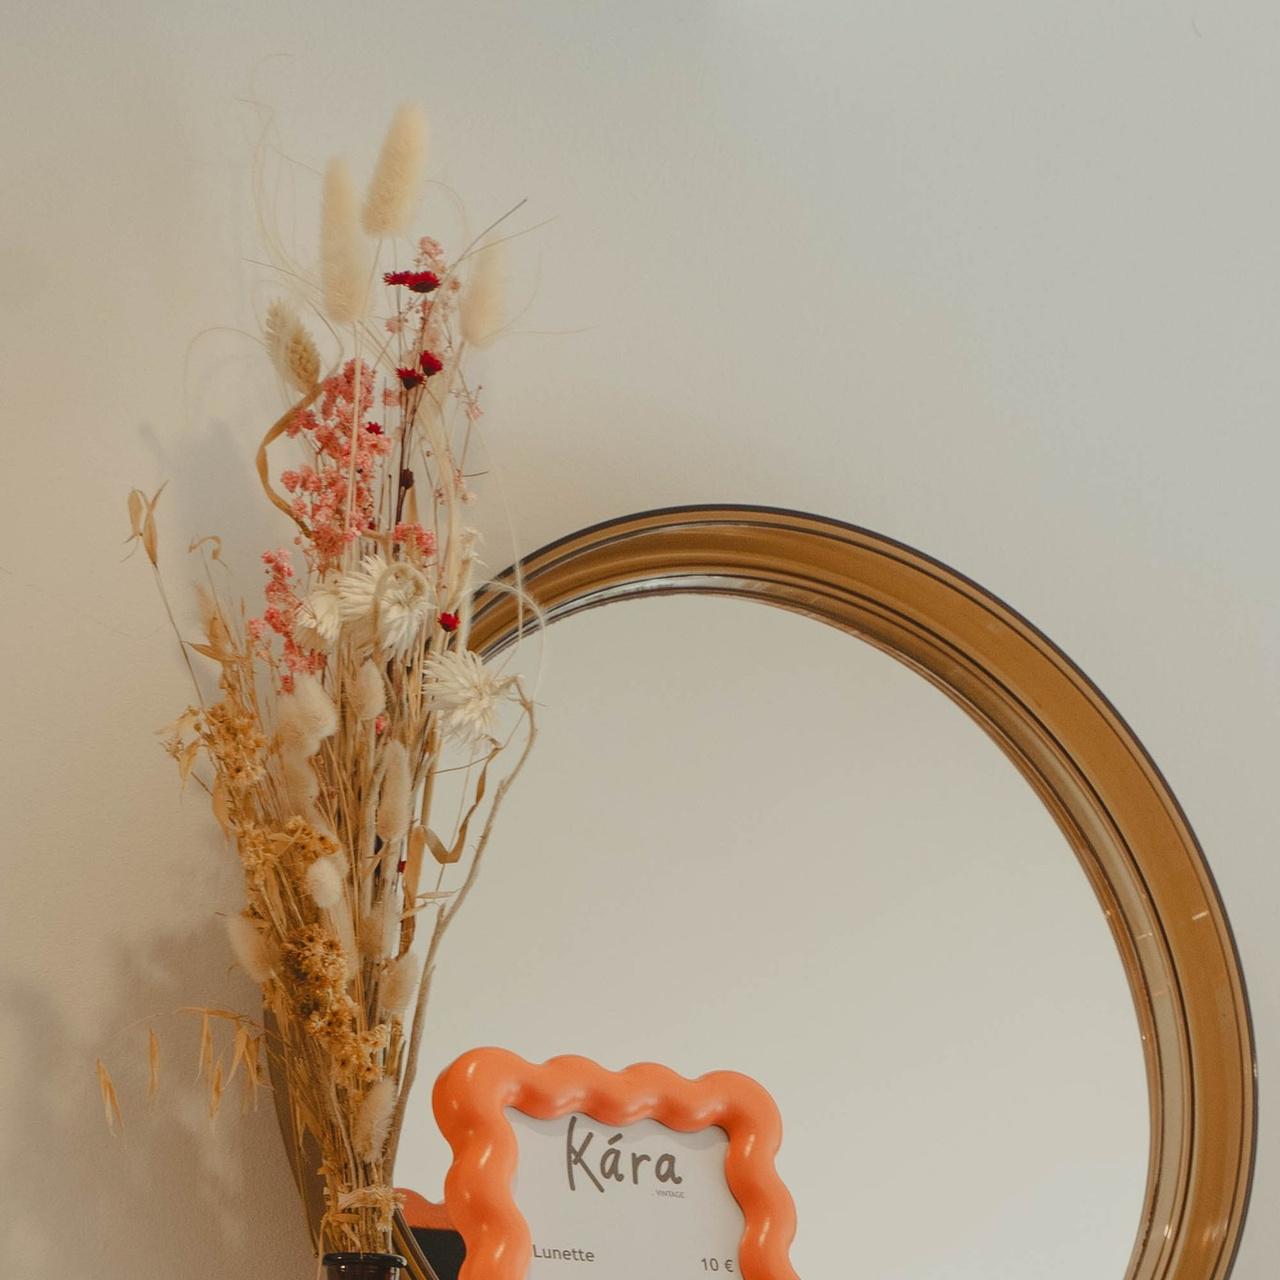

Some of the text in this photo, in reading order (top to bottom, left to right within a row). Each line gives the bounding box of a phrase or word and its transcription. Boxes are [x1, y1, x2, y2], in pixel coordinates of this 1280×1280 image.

[566, 1115, 683, 1193] Kára
[532, 1244, 734, 1273] Lunette 10 €
